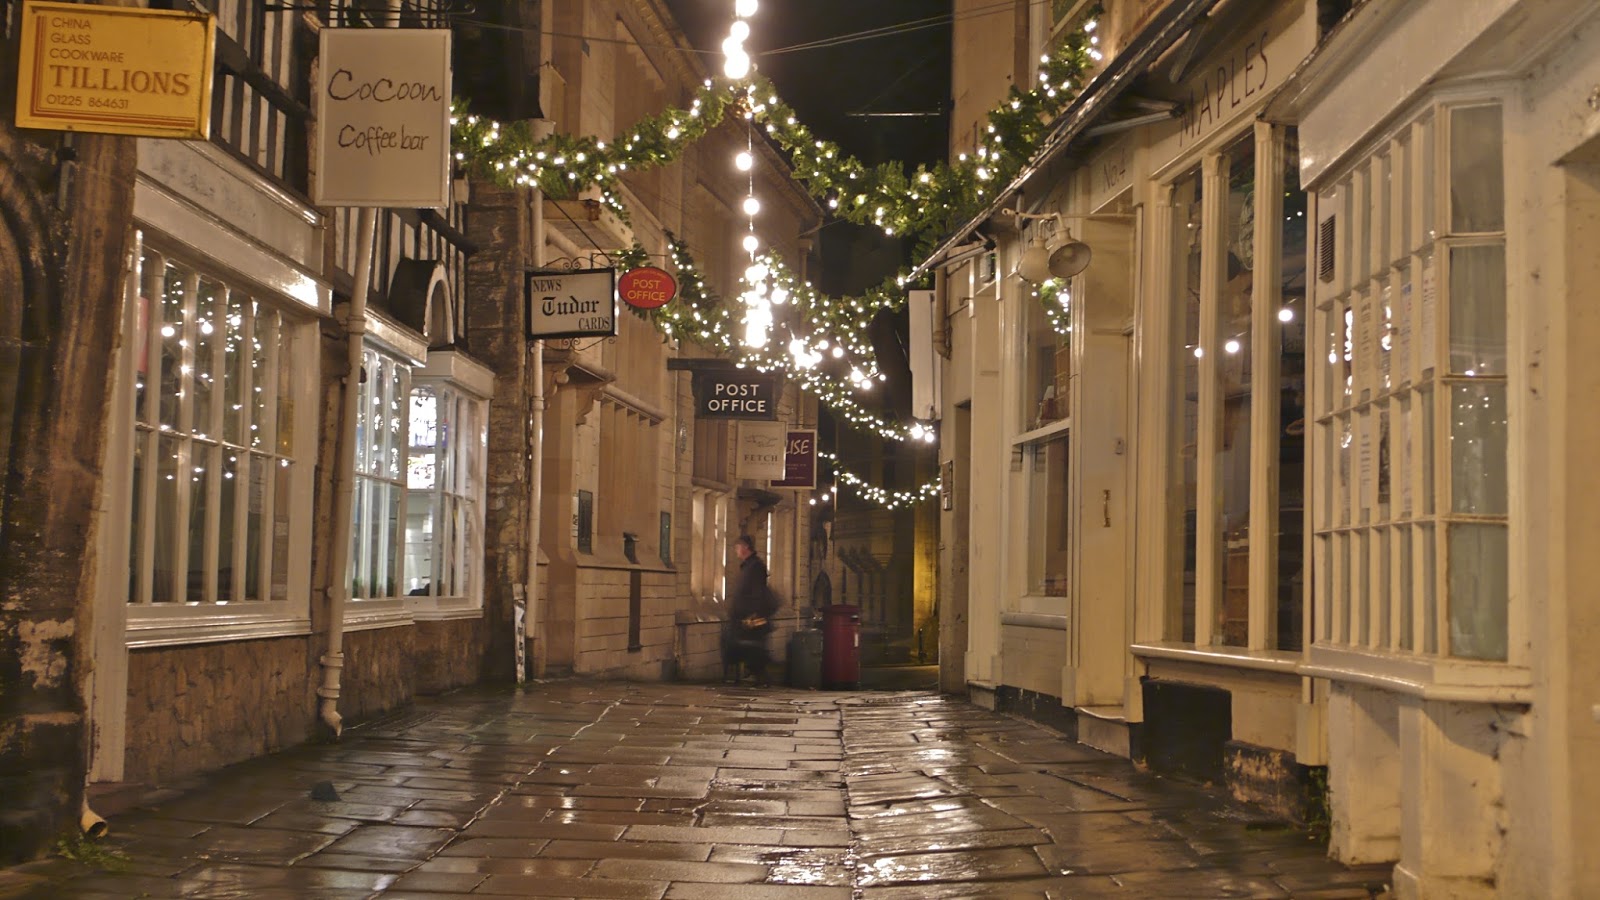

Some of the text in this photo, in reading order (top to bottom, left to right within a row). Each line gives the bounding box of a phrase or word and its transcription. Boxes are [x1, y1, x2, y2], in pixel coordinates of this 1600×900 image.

[51, 17, 92, 30] CHINA
[51, 32, 91, 45] GLASS
[49, 48, 125, 63] COOKWARE
[49, 64, 190, 97] TILLIONS
[1179, 31, 1269, 148] MAPLES
[46, 94, 129, 110] 01225 864631
[338, 124, 430, 156] Coffee bar
[532, 279, 562, 293] NEWS
[632, 278, 662, 290] POST
[626, 289, 667, 302] OFFICE
[542, 295, 600, 317] Tudor
[578, 316, 611, 331] CARDS
[715, 383, 760, 397] POST
[707, 399, 767, 413] OFFICE
[785, 439, 810, 455] LISE
[744, 454, 778, 462] FETCH
